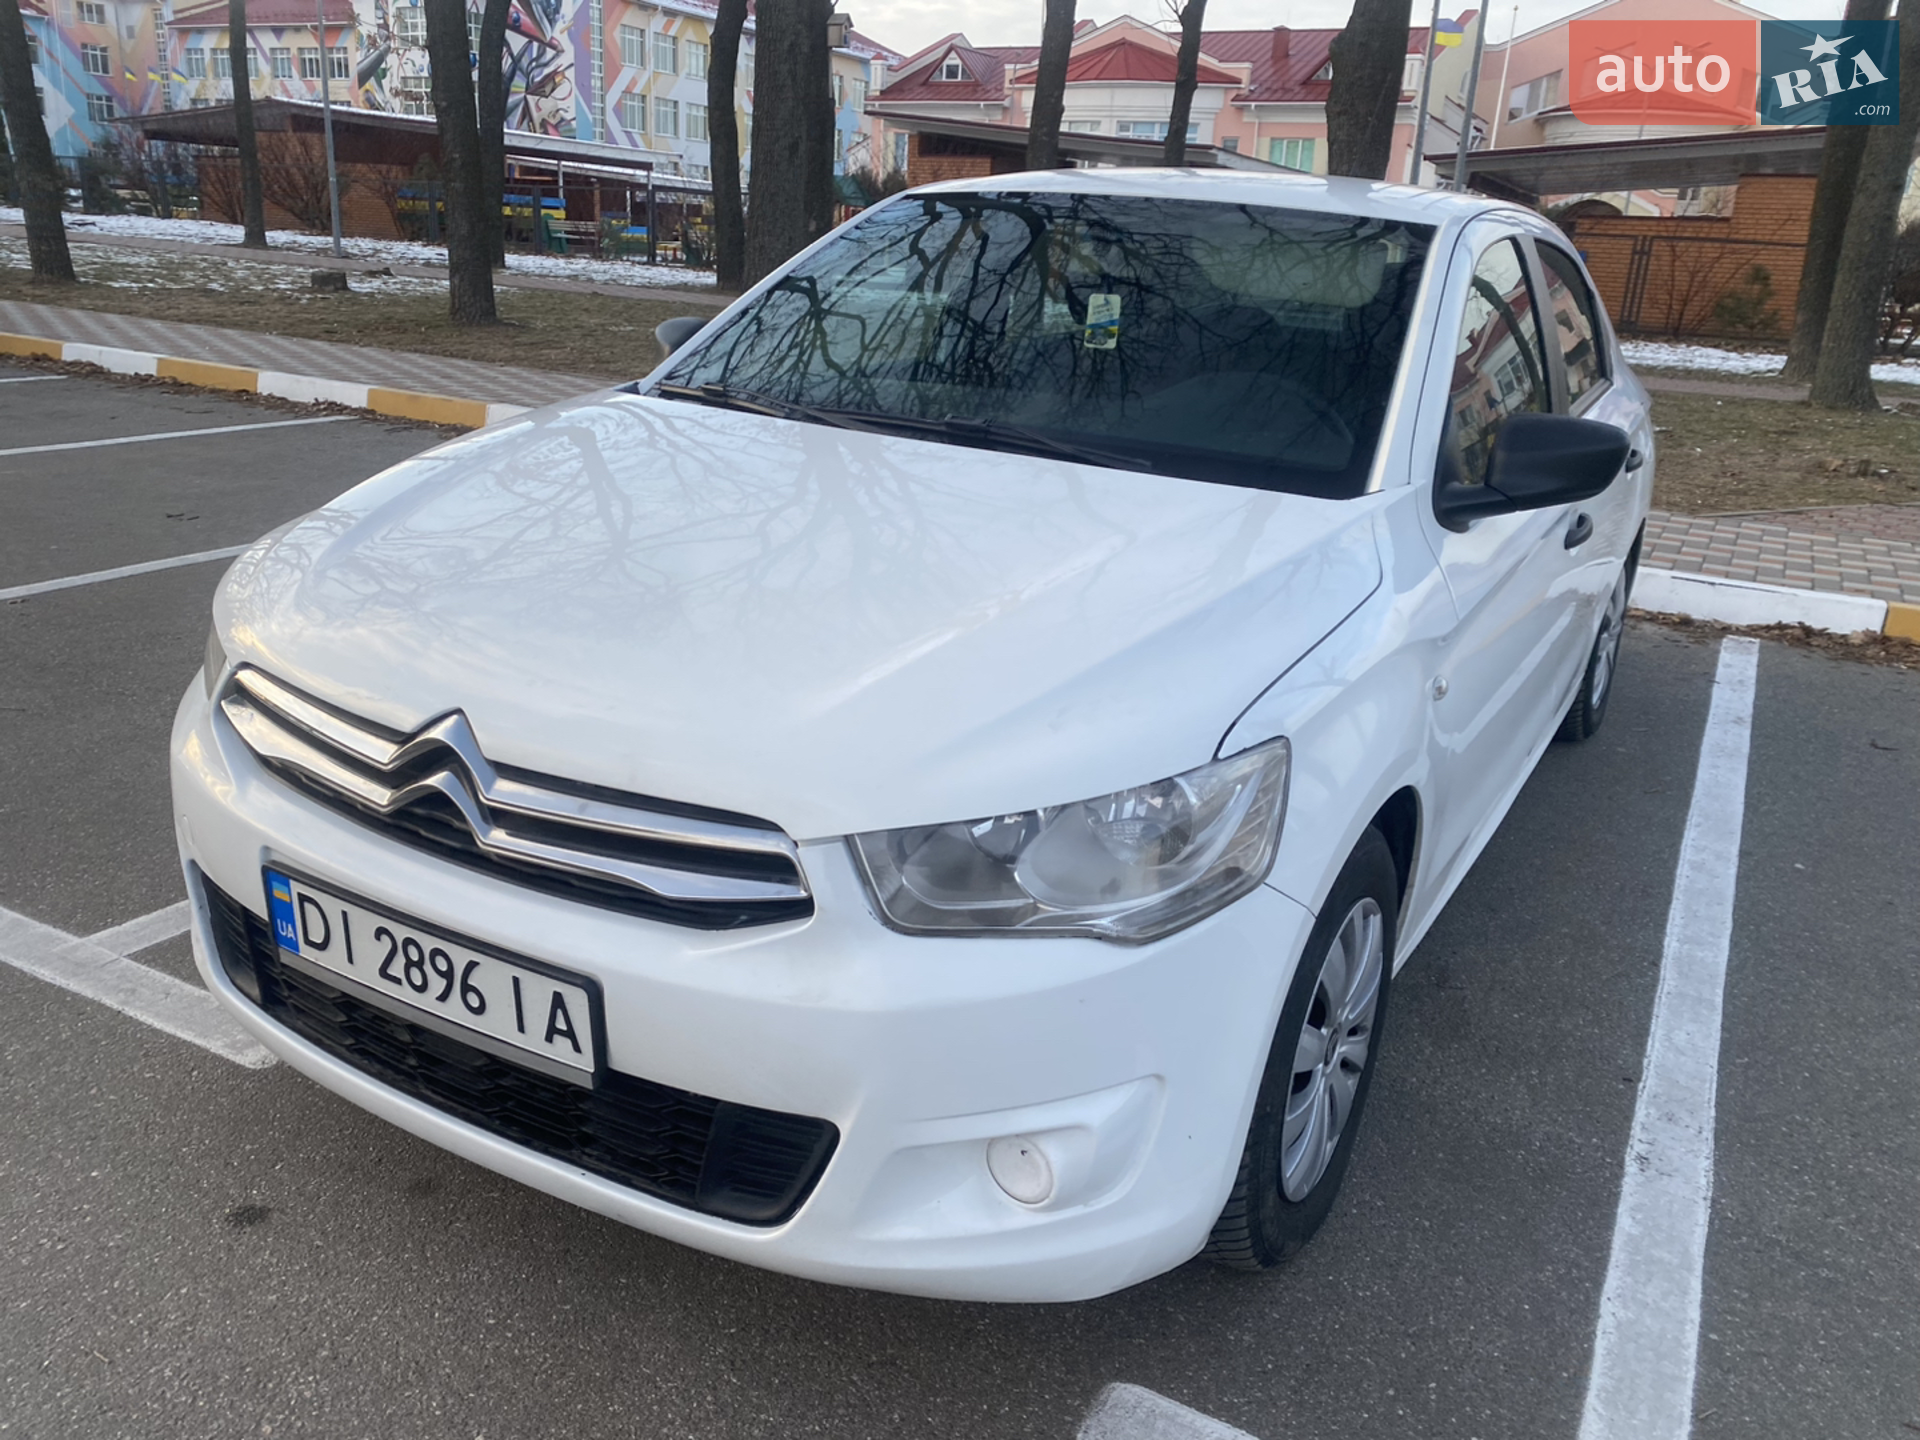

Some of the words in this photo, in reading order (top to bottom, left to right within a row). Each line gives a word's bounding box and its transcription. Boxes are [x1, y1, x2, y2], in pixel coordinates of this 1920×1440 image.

[277, 918, 297, 941] UA
[297, 891, 354, 965] DI
[374, 926, 487, 1016] 2896
[511, 975, 582, 1054] IA
